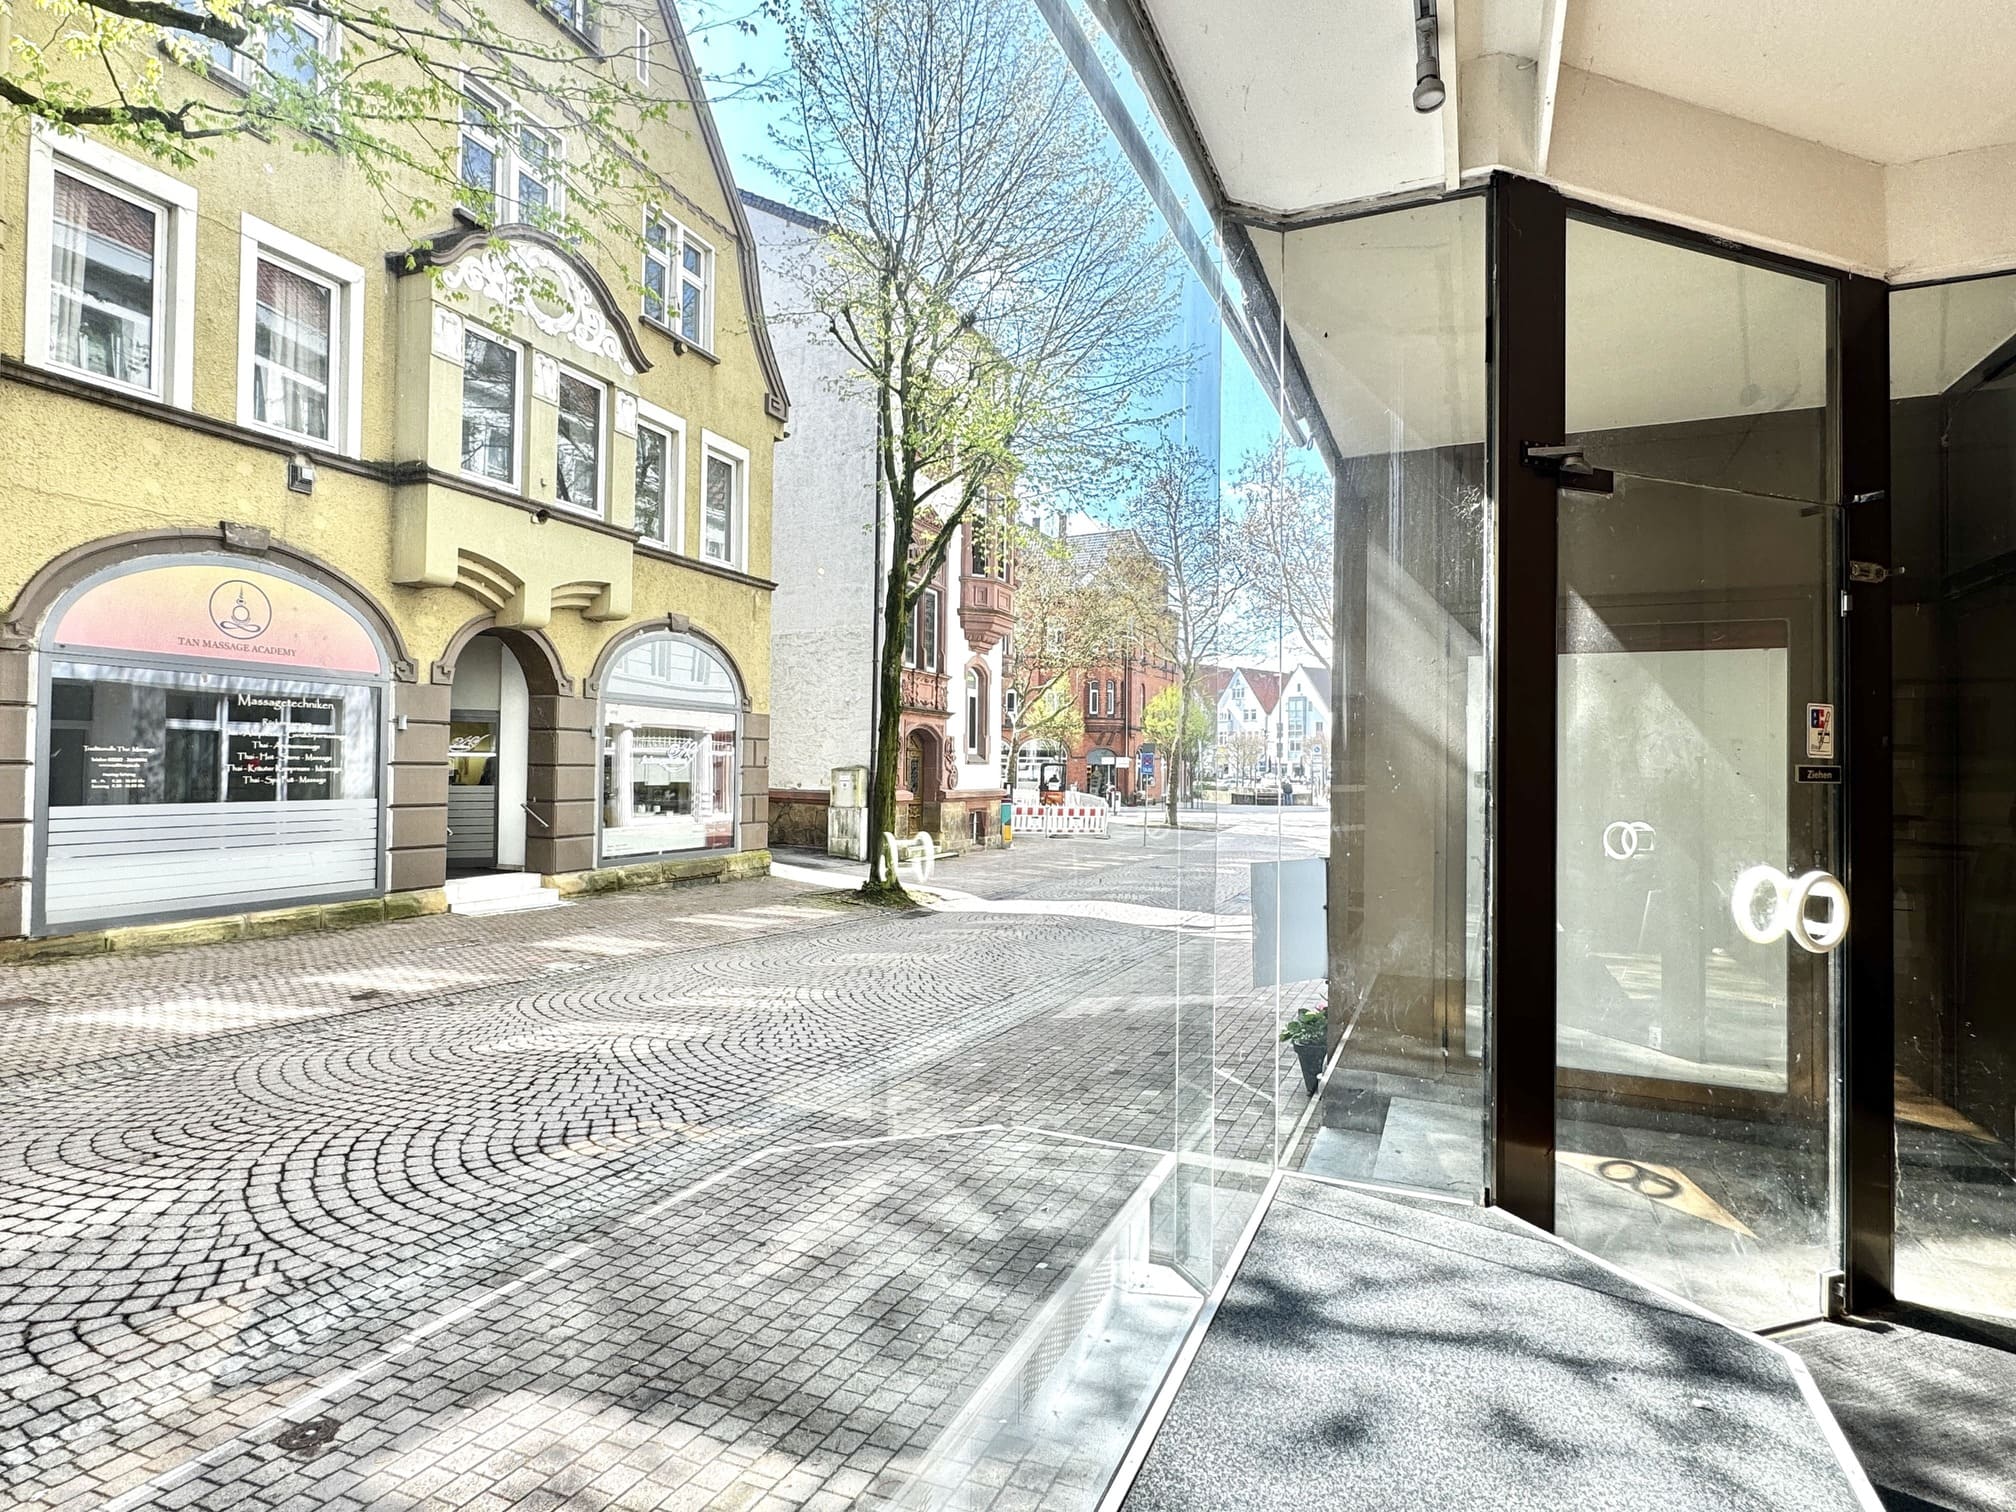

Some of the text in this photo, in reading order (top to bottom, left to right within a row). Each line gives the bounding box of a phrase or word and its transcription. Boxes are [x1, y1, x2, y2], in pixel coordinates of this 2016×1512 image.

[178, 636, 297, 657] TAN MASSAGE ACADEMY
[237, 694, 334, 710] Massagetechniken
[1807, 769, 1833, 779] Ziehen
